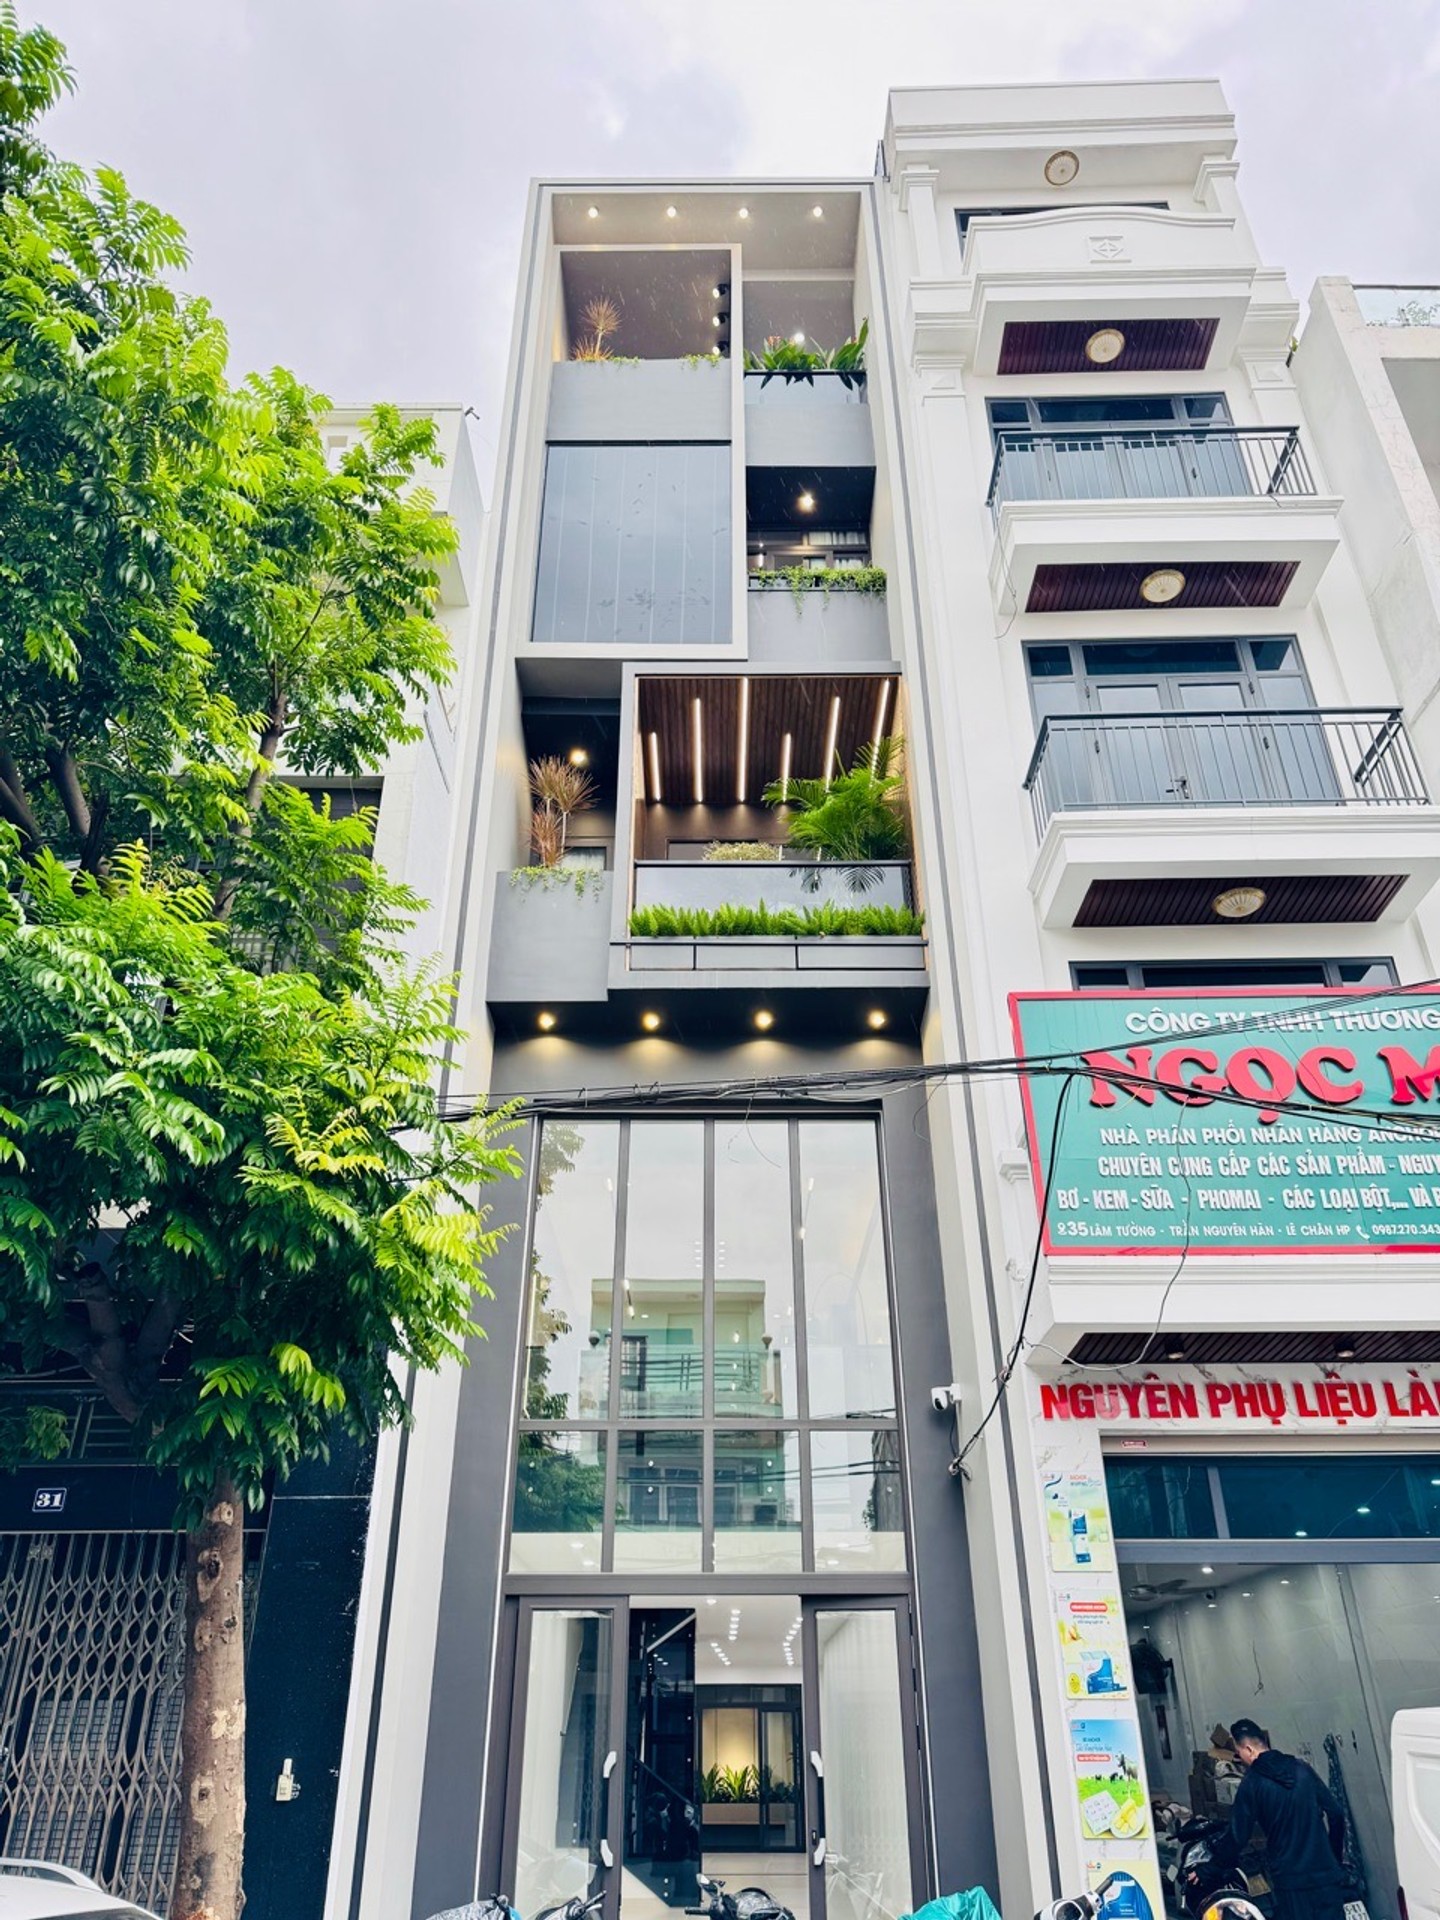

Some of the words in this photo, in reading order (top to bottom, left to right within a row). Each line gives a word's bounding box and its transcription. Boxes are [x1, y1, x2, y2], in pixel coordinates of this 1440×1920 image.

[1125, 1007, 1211, 1033] CÔNG
[1215, 1011, 1246, 1032] TY
[1251, 1010, 1324, 1032] TNHH
[1329, 1007, 1440, 1031] THƯƠNG
[1080, 1045, 1364, 1124] NGỌC
[1100, 1123, 1140, 1145] NHÀ
[1145, 1124, 1197, 1145] PHÂN
[1201, 1119, 1247, 1145] PHỐI
[1306, 1122, 1362, 1143] HÀNG
[1098, 1152, 1163, 1177] CHUYÊN
[1167, 1156, 1213, 1177] CUNG
[1218, 1149, 1251, 1176] CẤP
[1257, 1152, 1291, 1176] CÁC
[1296, 1149, 1332, 1176] SẢN
[1335, 1146, 1386, 1175] PHẨM
[1056, 1188, 1080, 1210] BƠ
[1092, 1189, 1130, 1210] KEM
[1140, 1184, 1175, 1210] SỮA
[1197, 1189, 1262, 1210] PHOMAI
[1282, 1184, 1316, 1209] CÁC
[1320, 1188, 1360, 1213] LOẠI
[1408, 1183, 1433, 1209] VÀ
[1116, 1220, 1157, 1237] TƯỜNG
[1203, 1222, 1247, 1237] NGUYÊN
[1286, 1222, 1297, 1236] LÊ
[1300, 1223, 1334, 1236] CHÂN
[1335, 1224, 1351, 1236] HP
[1040, 1371, 1200, 1421] NGUYÊN
[1204, 1381, 1287, 1425] PHỤ
[1291, 1371, 1378, 1425] LIỆU
[1382, 1369, 1440, 1418] LÀ
[36, 1492, 64, 1508] 31
